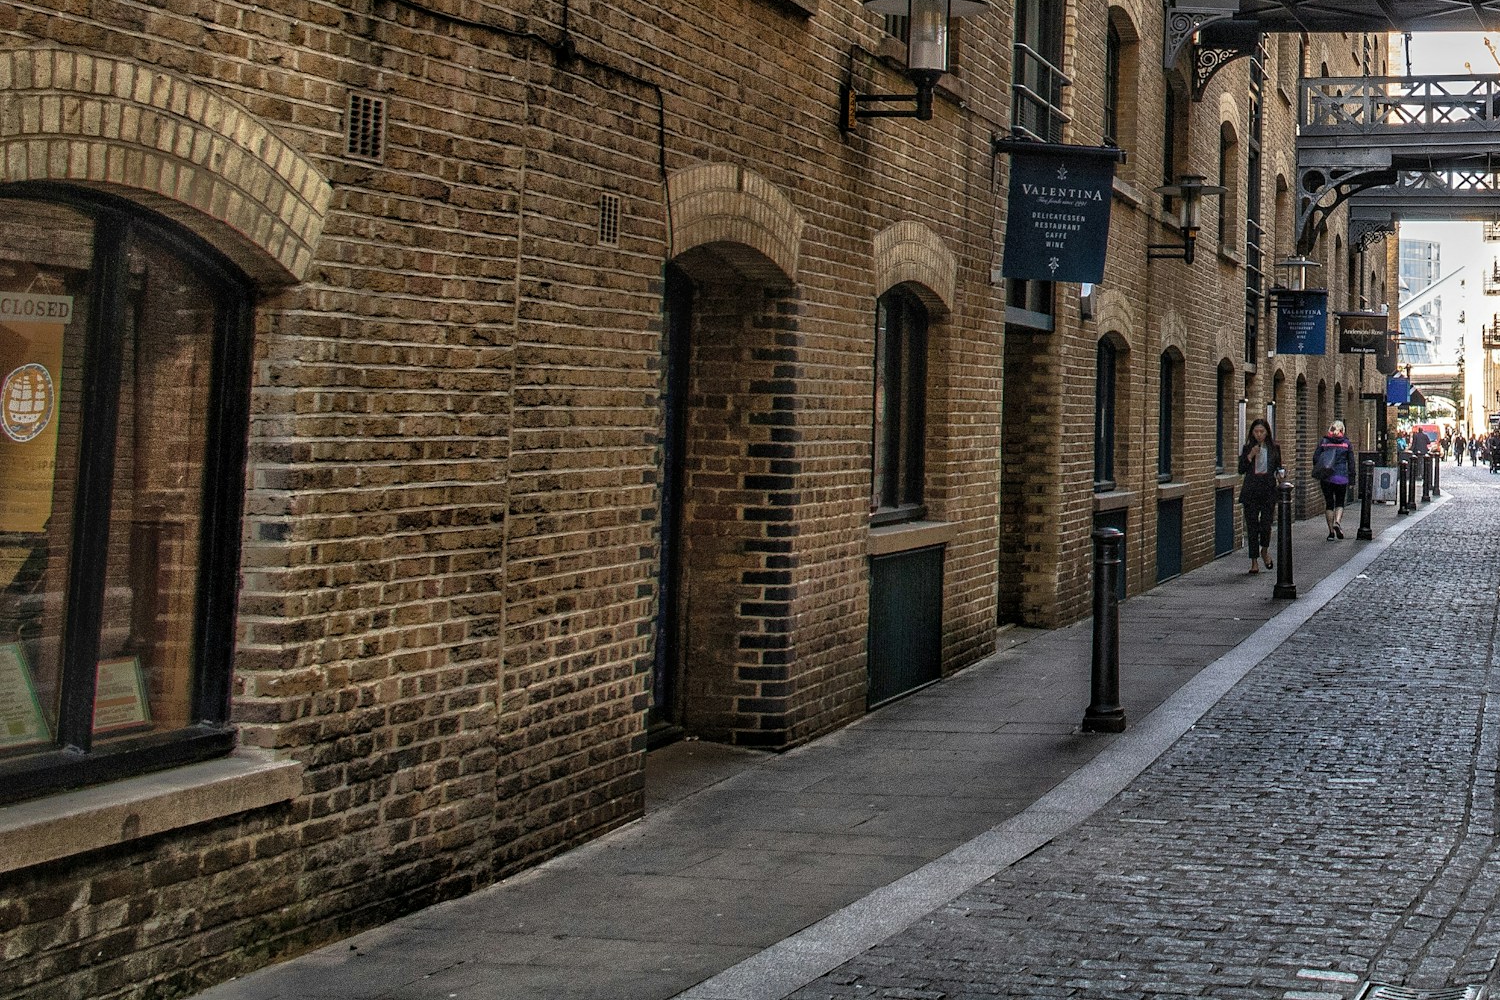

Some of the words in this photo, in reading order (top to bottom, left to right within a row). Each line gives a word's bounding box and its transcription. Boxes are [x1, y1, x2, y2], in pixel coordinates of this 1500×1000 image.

[1022, 184, 1102, 201] VALENTINA
[1032, 211, 1086, 222] DELICATESSEN
[1035, 221, 1081, 231] RESTAURANT
[1045, 241, 1064, 249] WINE
[1, 298, 69, 318] CLOSED
